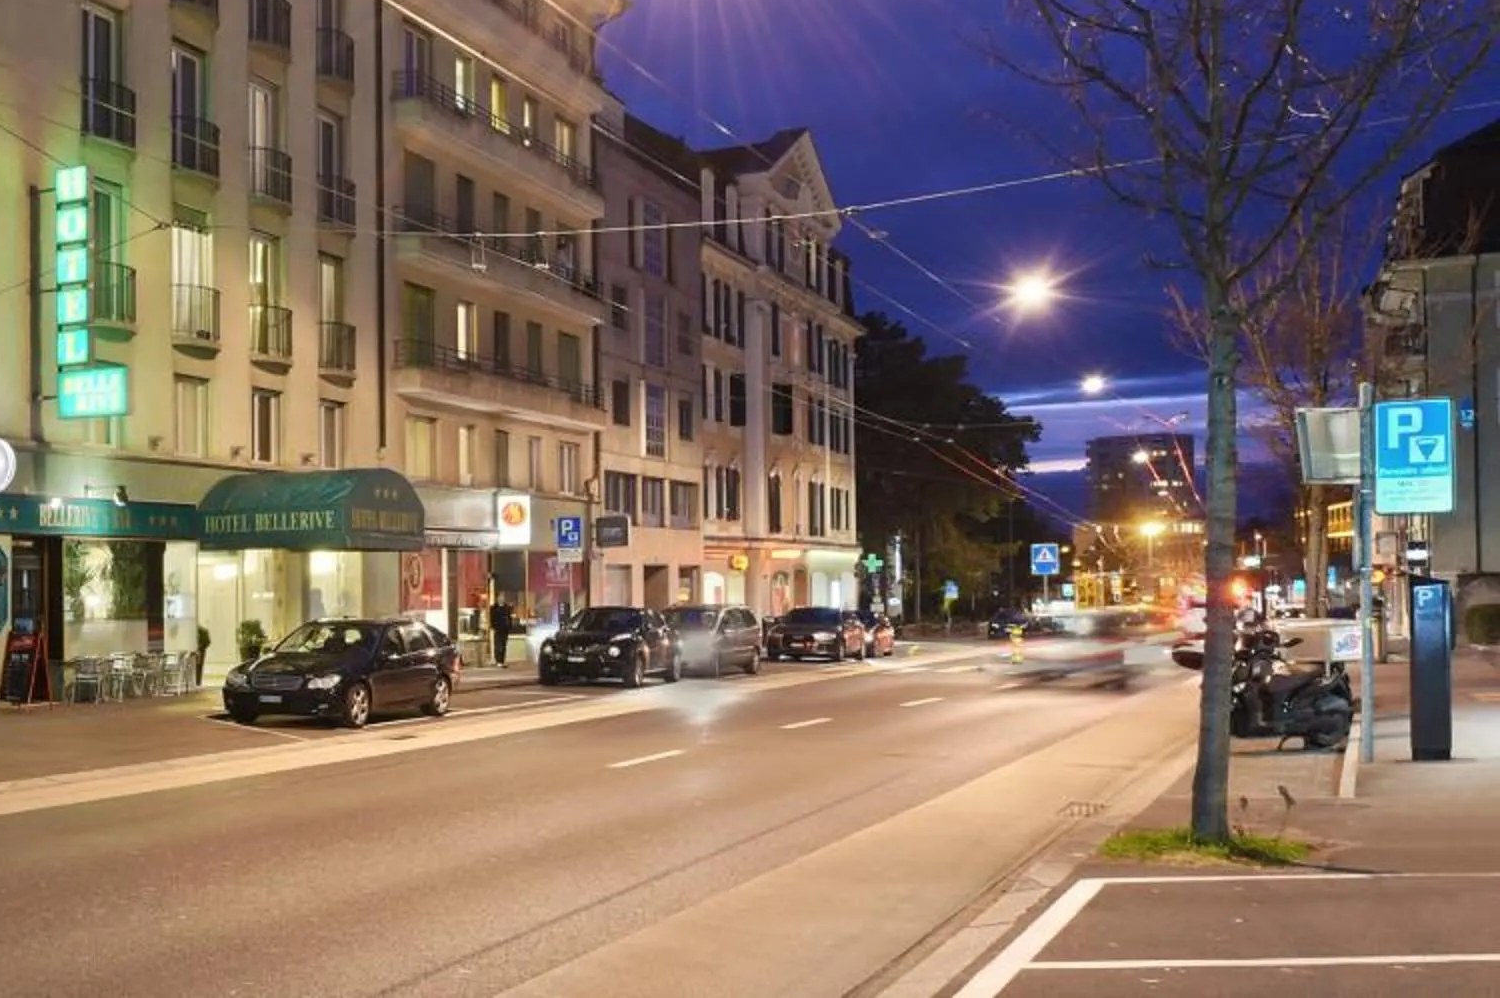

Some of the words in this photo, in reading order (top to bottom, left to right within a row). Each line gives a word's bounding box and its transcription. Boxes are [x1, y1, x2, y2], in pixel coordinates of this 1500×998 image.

[60, 169, 84, 359] HOTEL
[1388, 407, 1423, 449] P
[204, 513, 249, 533] HOTEL
[254, 510, 336, 532] BELLERIVE
[561, 519, 573, 535] P
[1418, 590, 1434, 607] P
